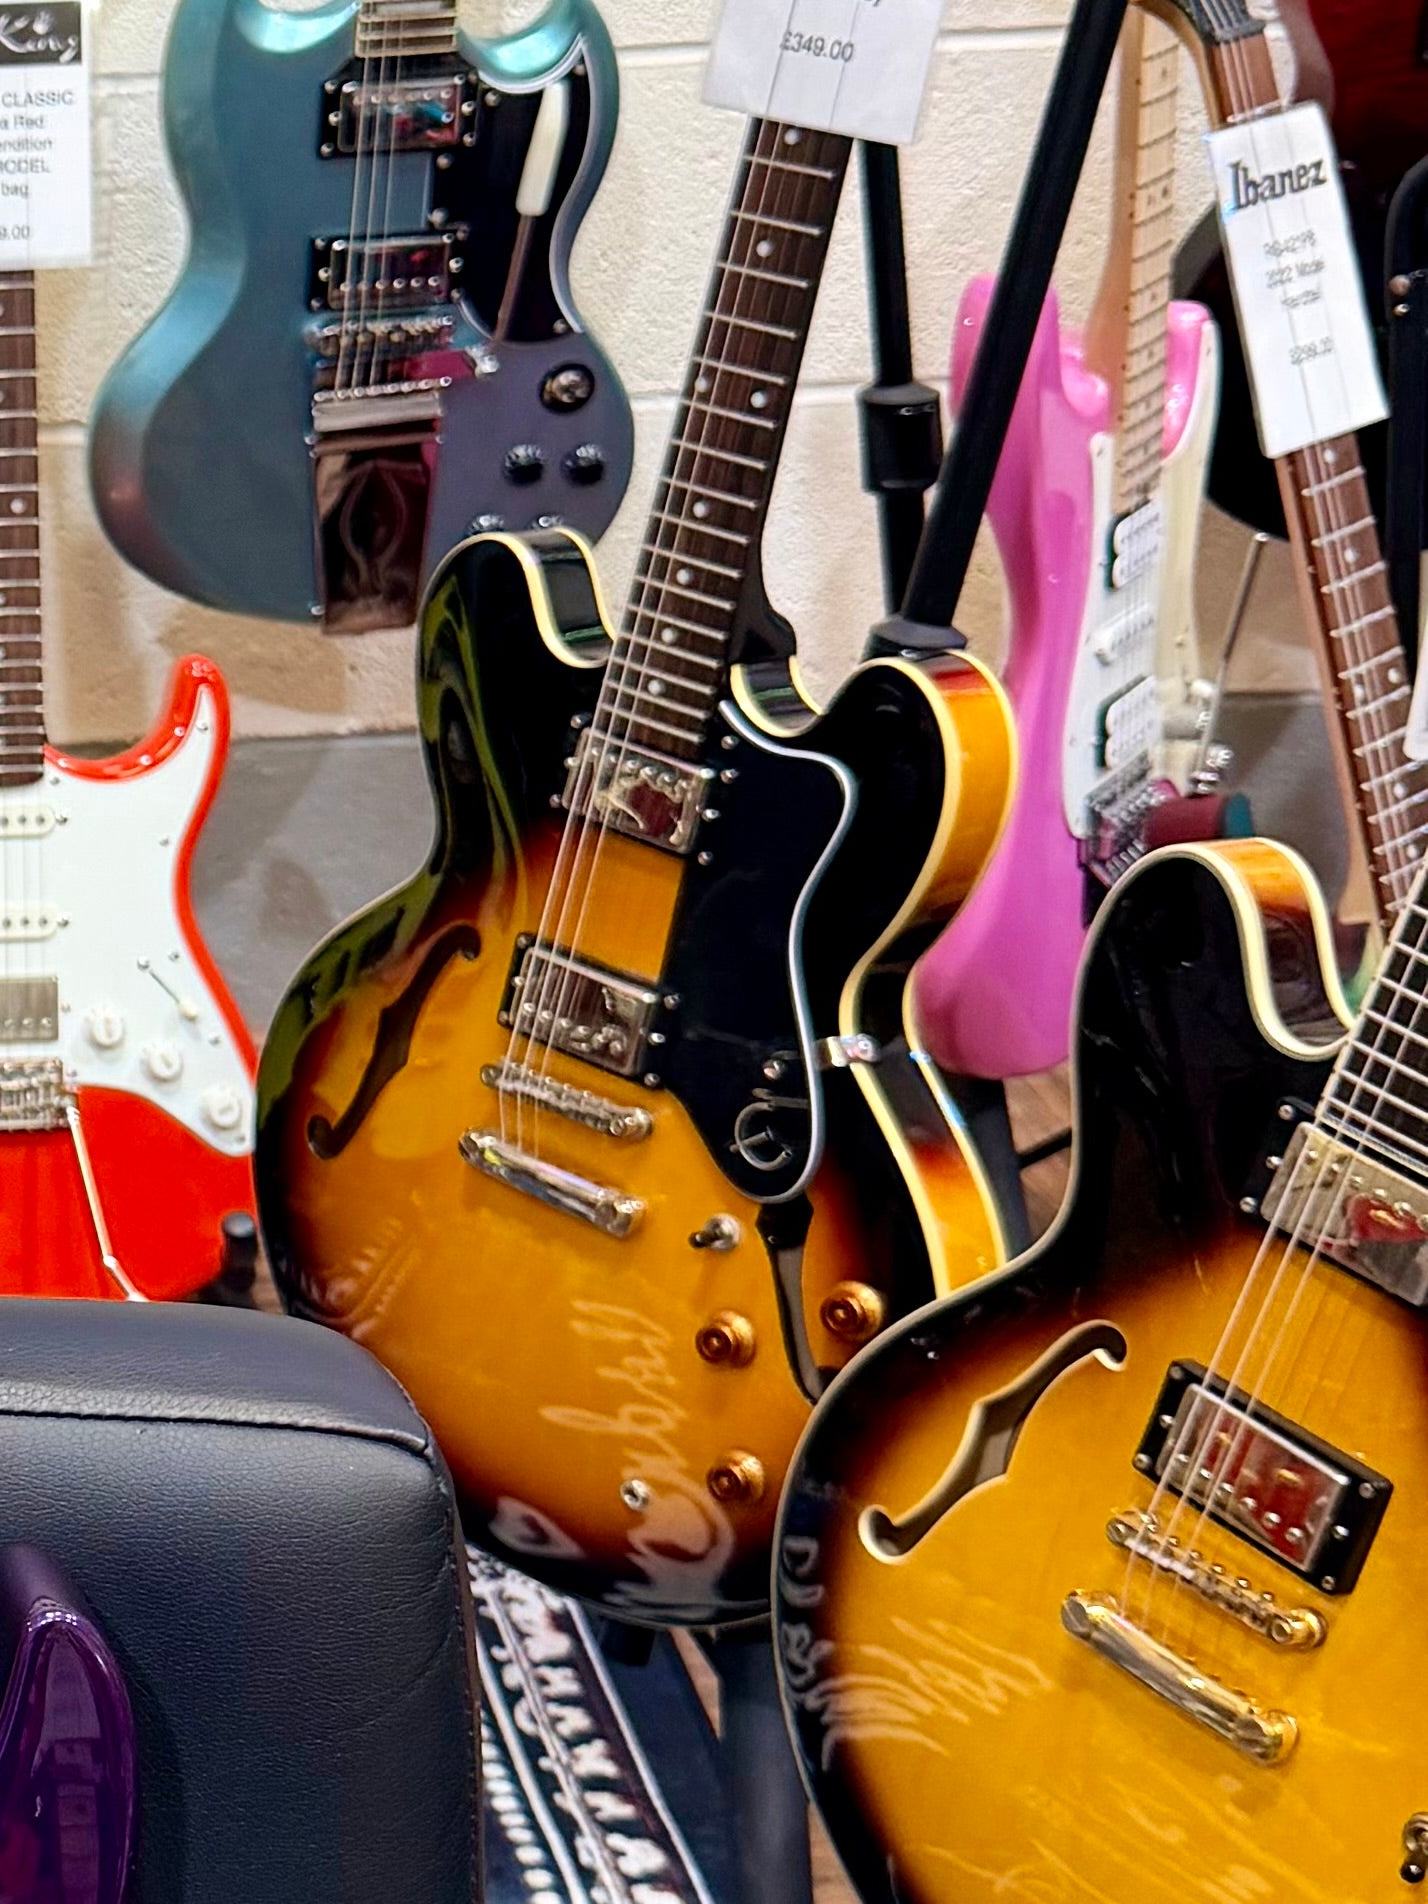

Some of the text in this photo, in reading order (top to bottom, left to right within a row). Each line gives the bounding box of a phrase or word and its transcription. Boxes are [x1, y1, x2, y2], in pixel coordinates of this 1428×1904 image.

[780, 31, 855, 63] £349.00
[1, 90, 75, 109] CLASSIC
[13, 114, 44, 130] Red
[1228, 158, 1328, 210] Ibanez
